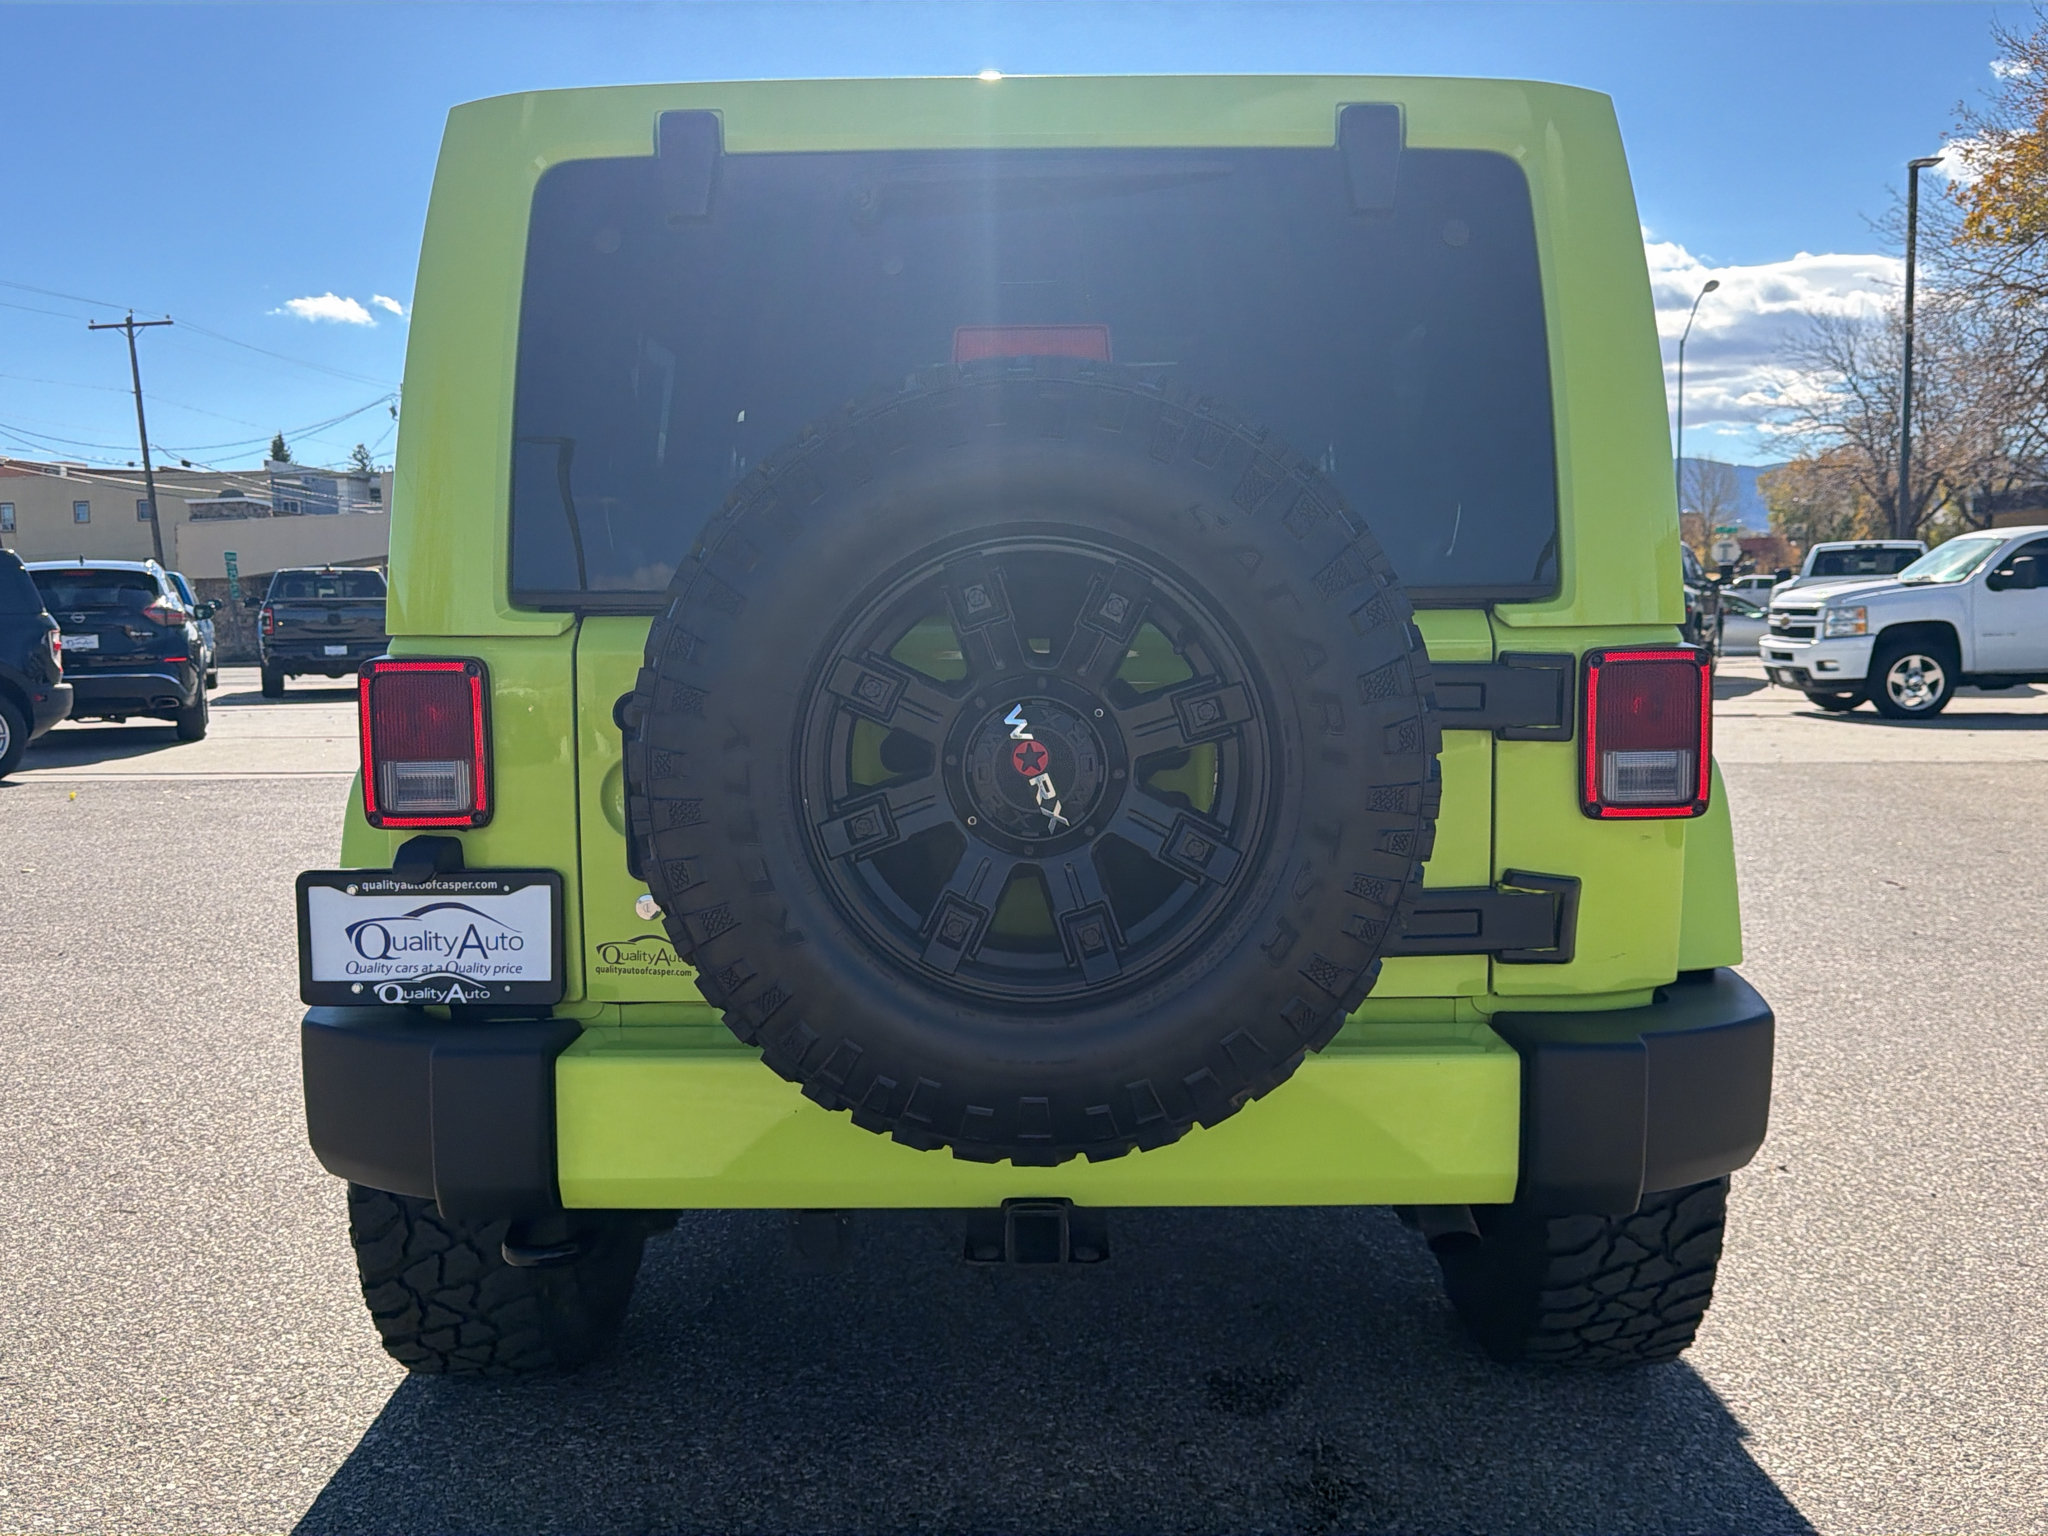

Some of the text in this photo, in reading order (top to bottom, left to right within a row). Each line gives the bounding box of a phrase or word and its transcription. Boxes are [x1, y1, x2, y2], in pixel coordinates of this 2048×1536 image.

[354, 923, 524, 960] QualityAuto
[602, 945, 682, 967] QualityAu
[345, 960, 523, 976] Quality cars at a Quality price
[595, 965, 693, 977] qualityautoofcasper.com
[378, 983, 491, 1004] QualityAuto
